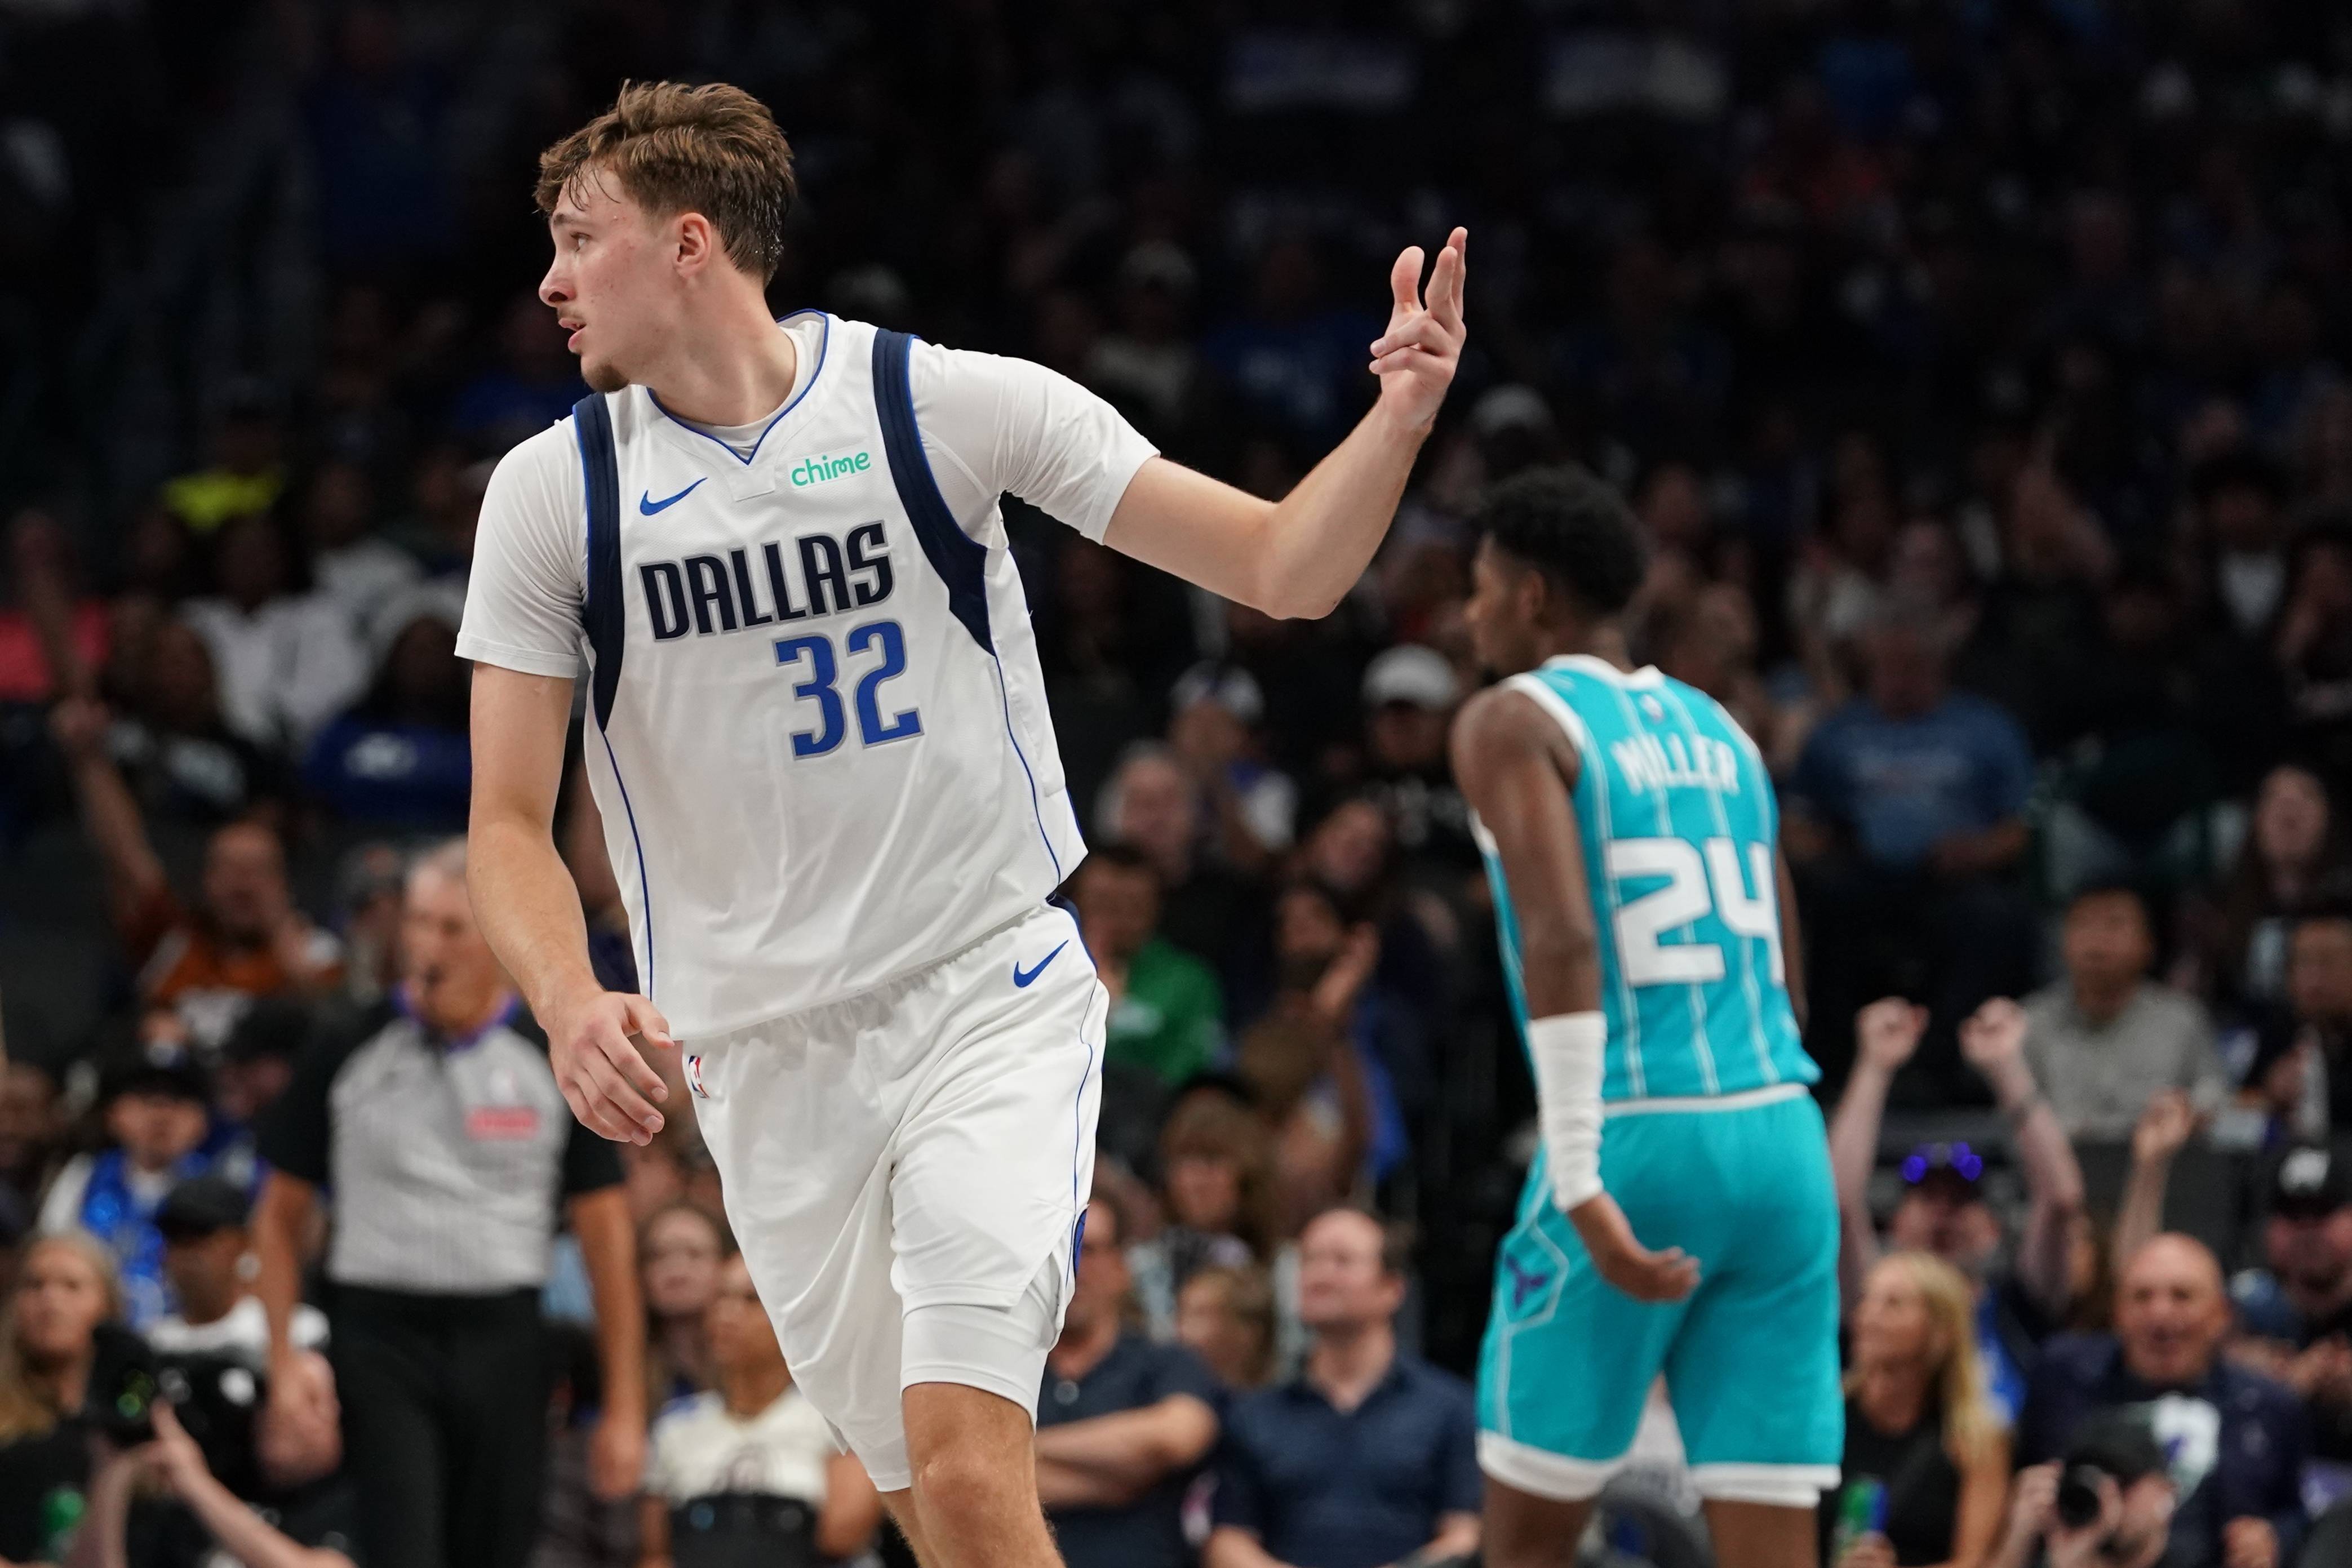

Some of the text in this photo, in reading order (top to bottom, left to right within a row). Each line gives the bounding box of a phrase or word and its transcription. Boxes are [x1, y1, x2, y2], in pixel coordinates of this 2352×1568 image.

[792, 451, 871, 487] chime
[637, 520, 895, 643] DALLAS
[771, 619, 925, 761] 32
[1610, 732, 1739, 796] MILLER
[1605, 836, 1786, 988] 24
